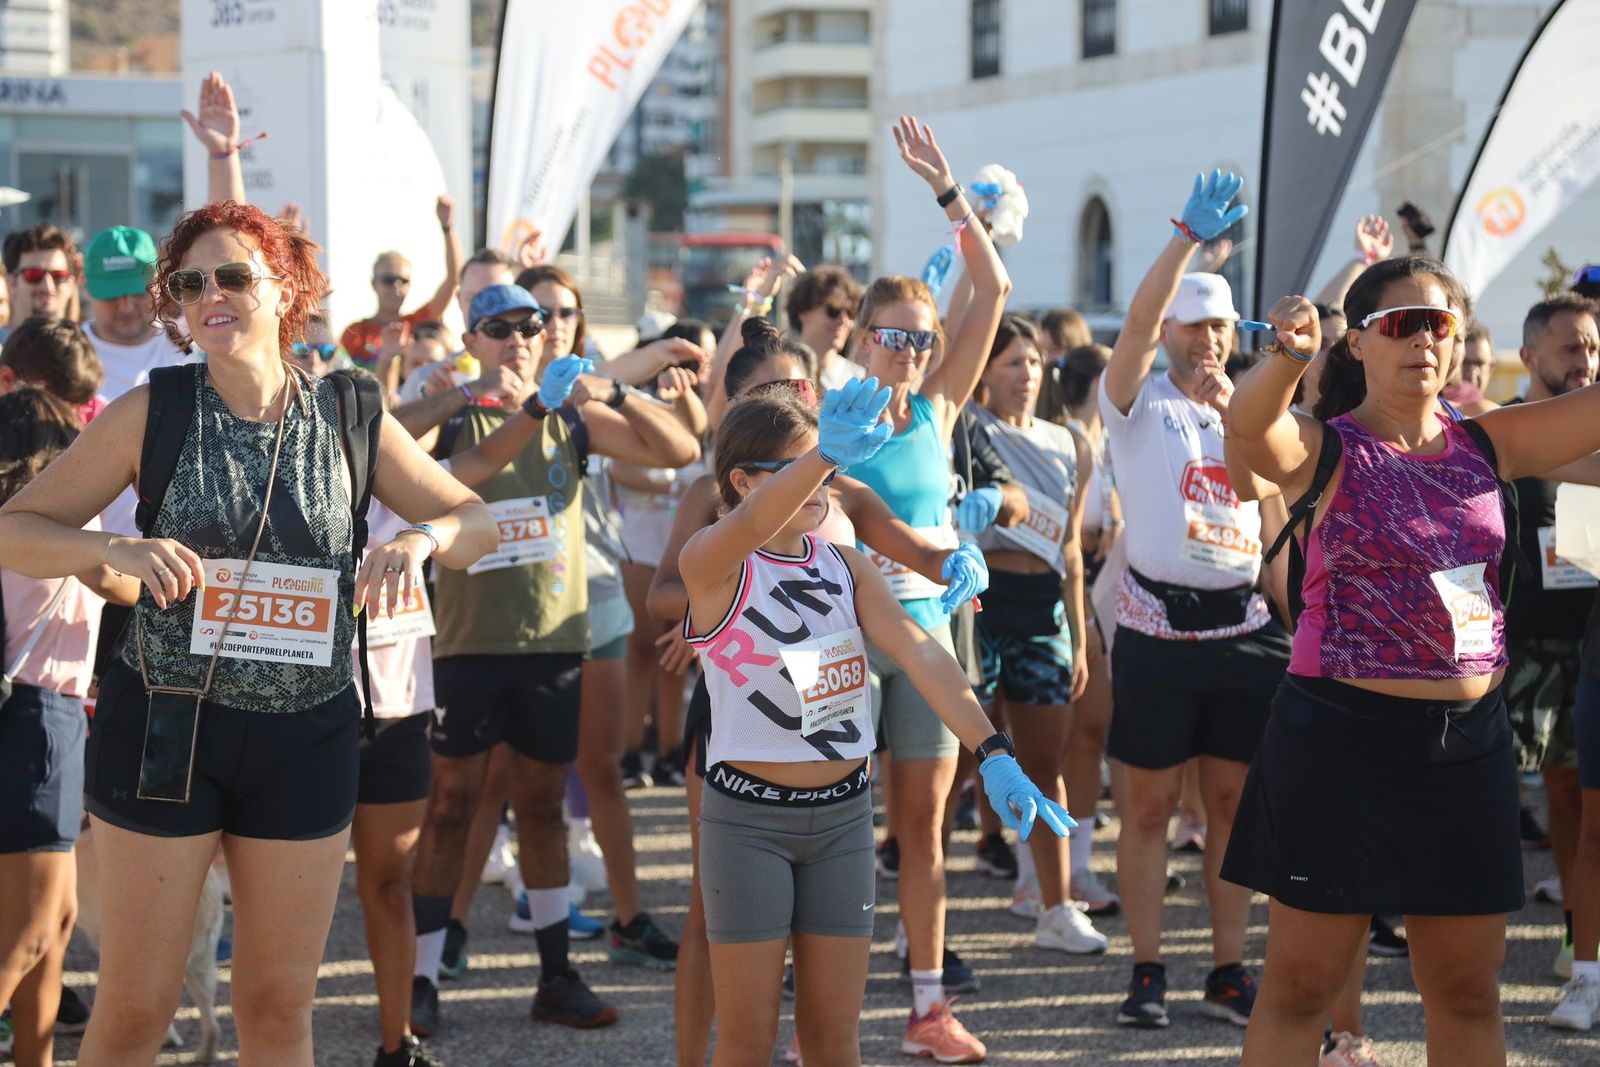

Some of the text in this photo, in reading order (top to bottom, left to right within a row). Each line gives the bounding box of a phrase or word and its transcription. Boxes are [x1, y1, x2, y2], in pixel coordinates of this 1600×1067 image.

[272, 576, 324, 593] PLOGGING
[215, 592, 316, 627] 25136
[713, 767, 780, 800] NIKE
[788, 781, 851, 802] PRO
